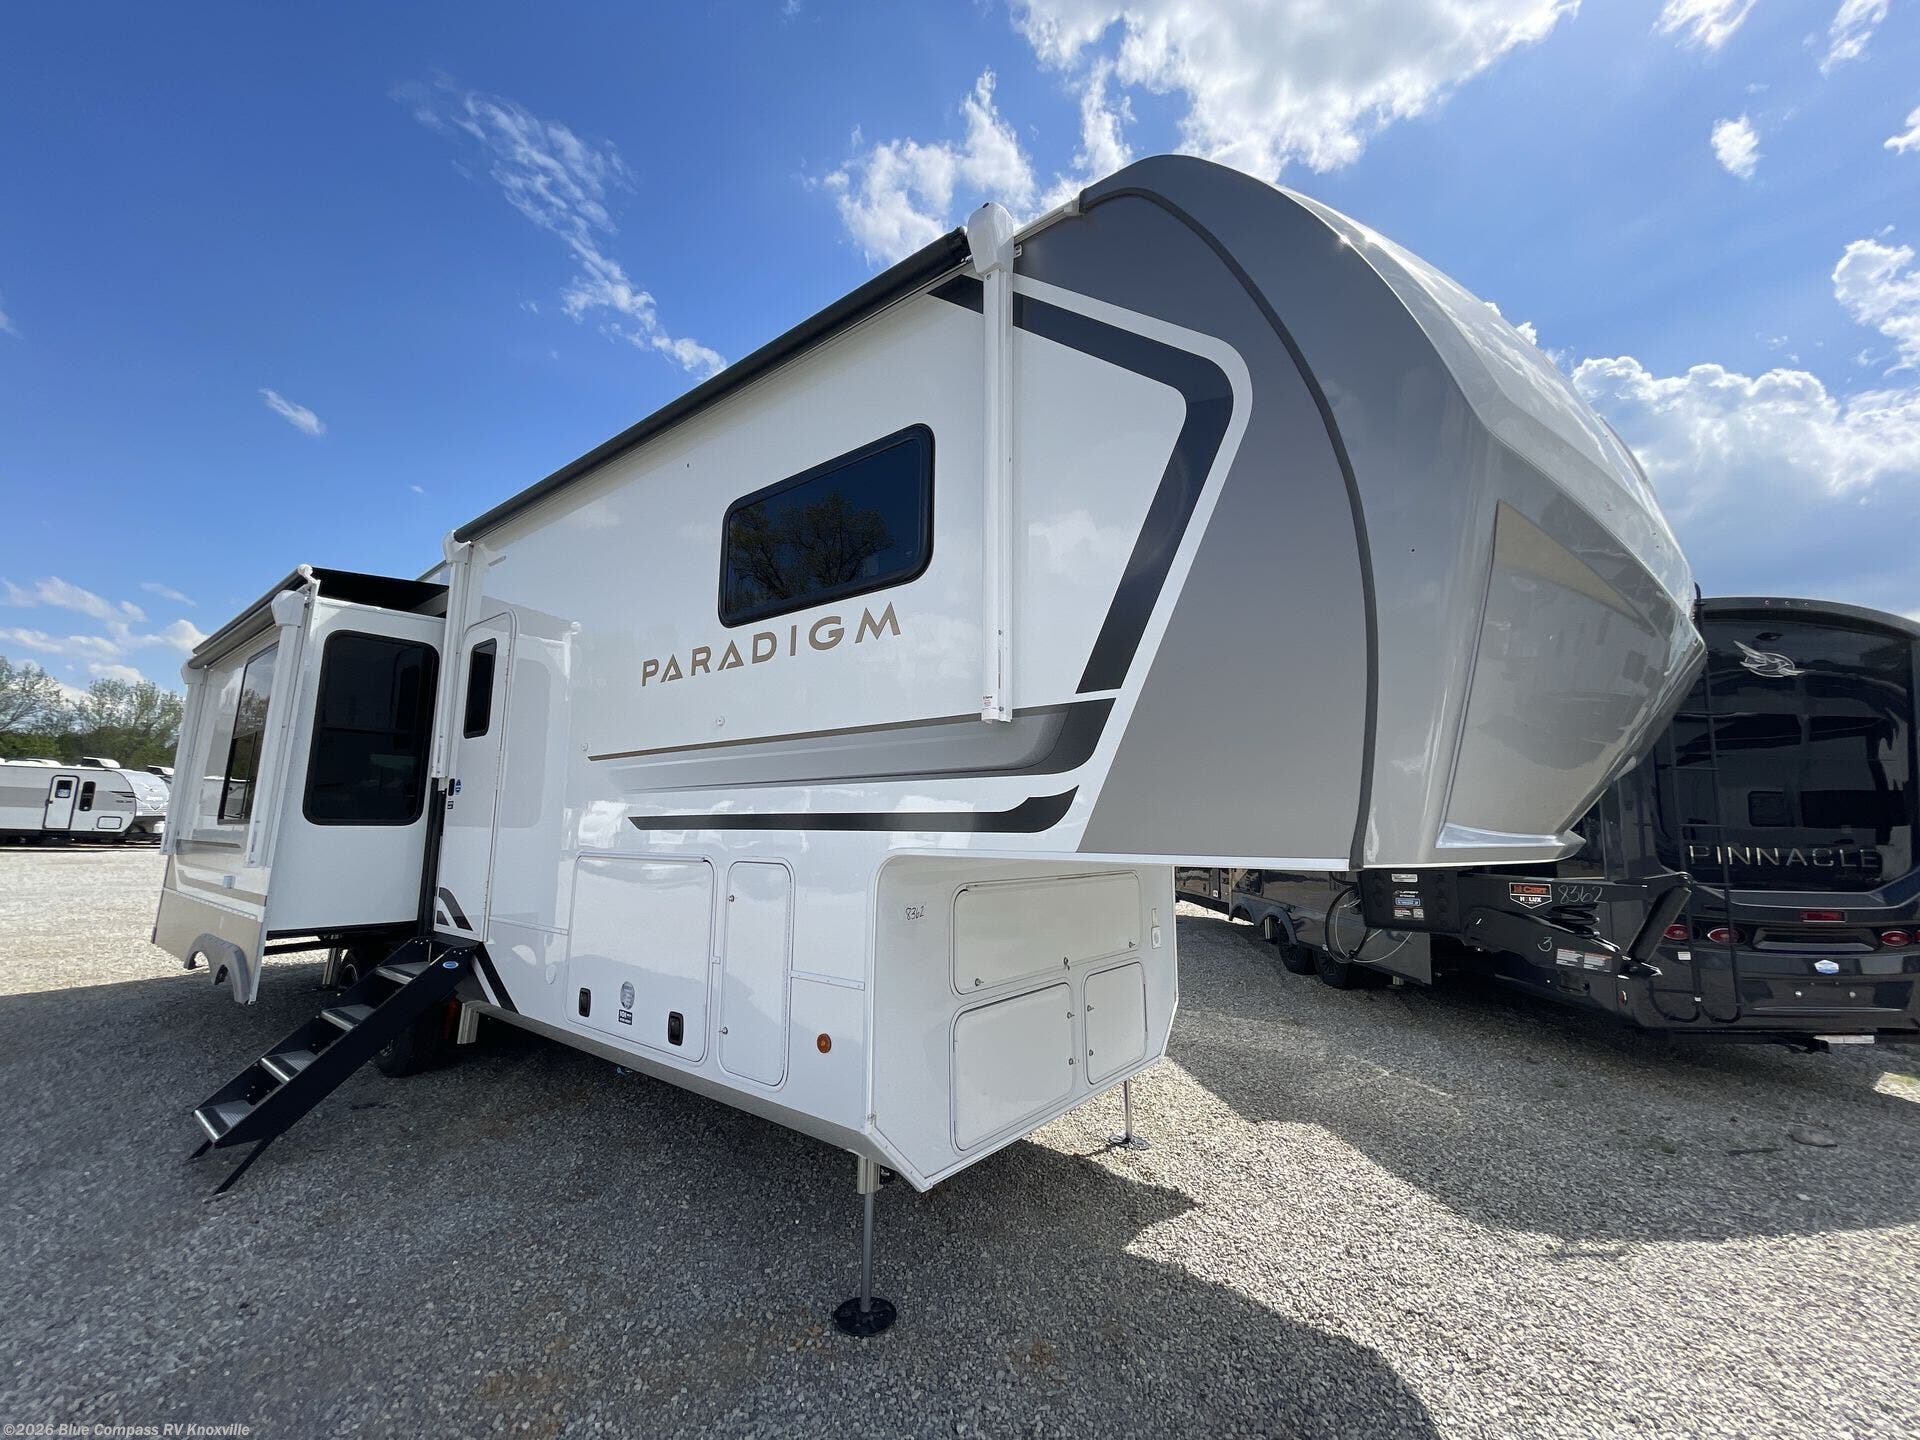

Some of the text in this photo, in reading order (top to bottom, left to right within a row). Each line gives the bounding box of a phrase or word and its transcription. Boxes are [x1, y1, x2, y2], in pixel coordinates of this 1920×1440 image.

[641, 601, 901, 687] PARADIGM
[1689, 845, 1879, 868] PINNACLE
[1558, 884, 1607, 904] 8362
